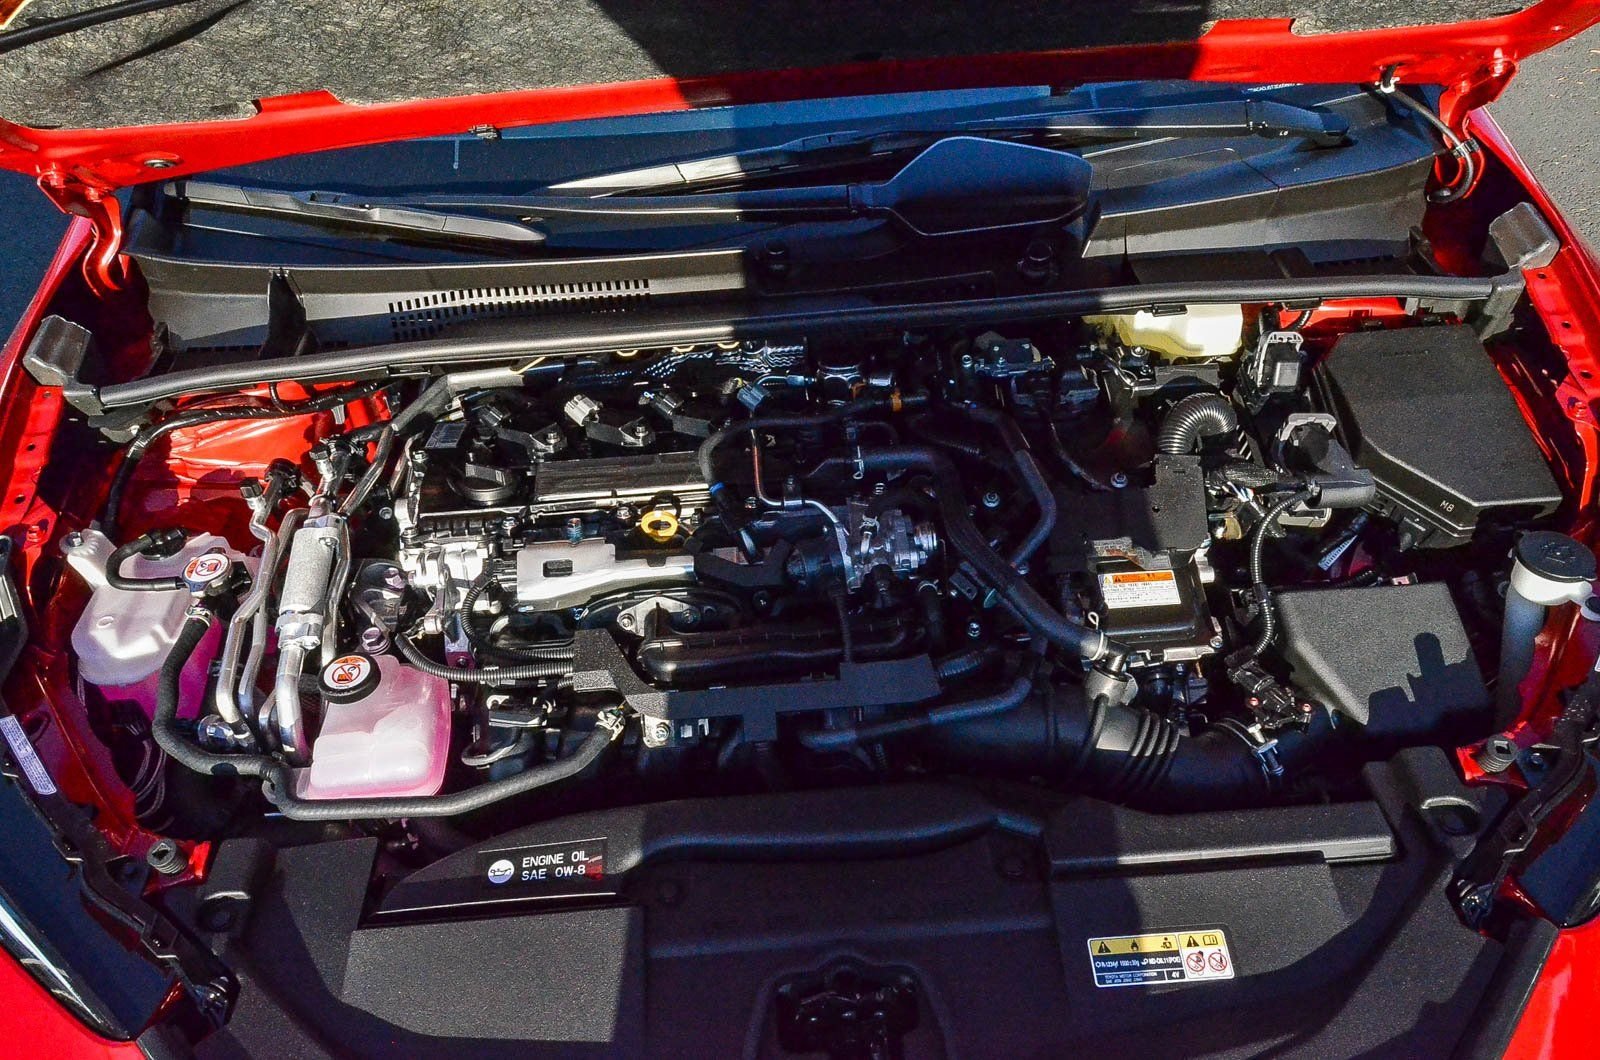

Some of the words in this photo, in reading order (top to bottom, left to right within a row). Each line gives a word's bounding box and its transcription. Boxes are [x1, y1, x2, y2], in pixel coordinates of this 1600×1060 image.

[522, 853, 565, 868] ENGINE
[571, 850, 590, 862] OIL
[521, 868, 547, 880] SAE
